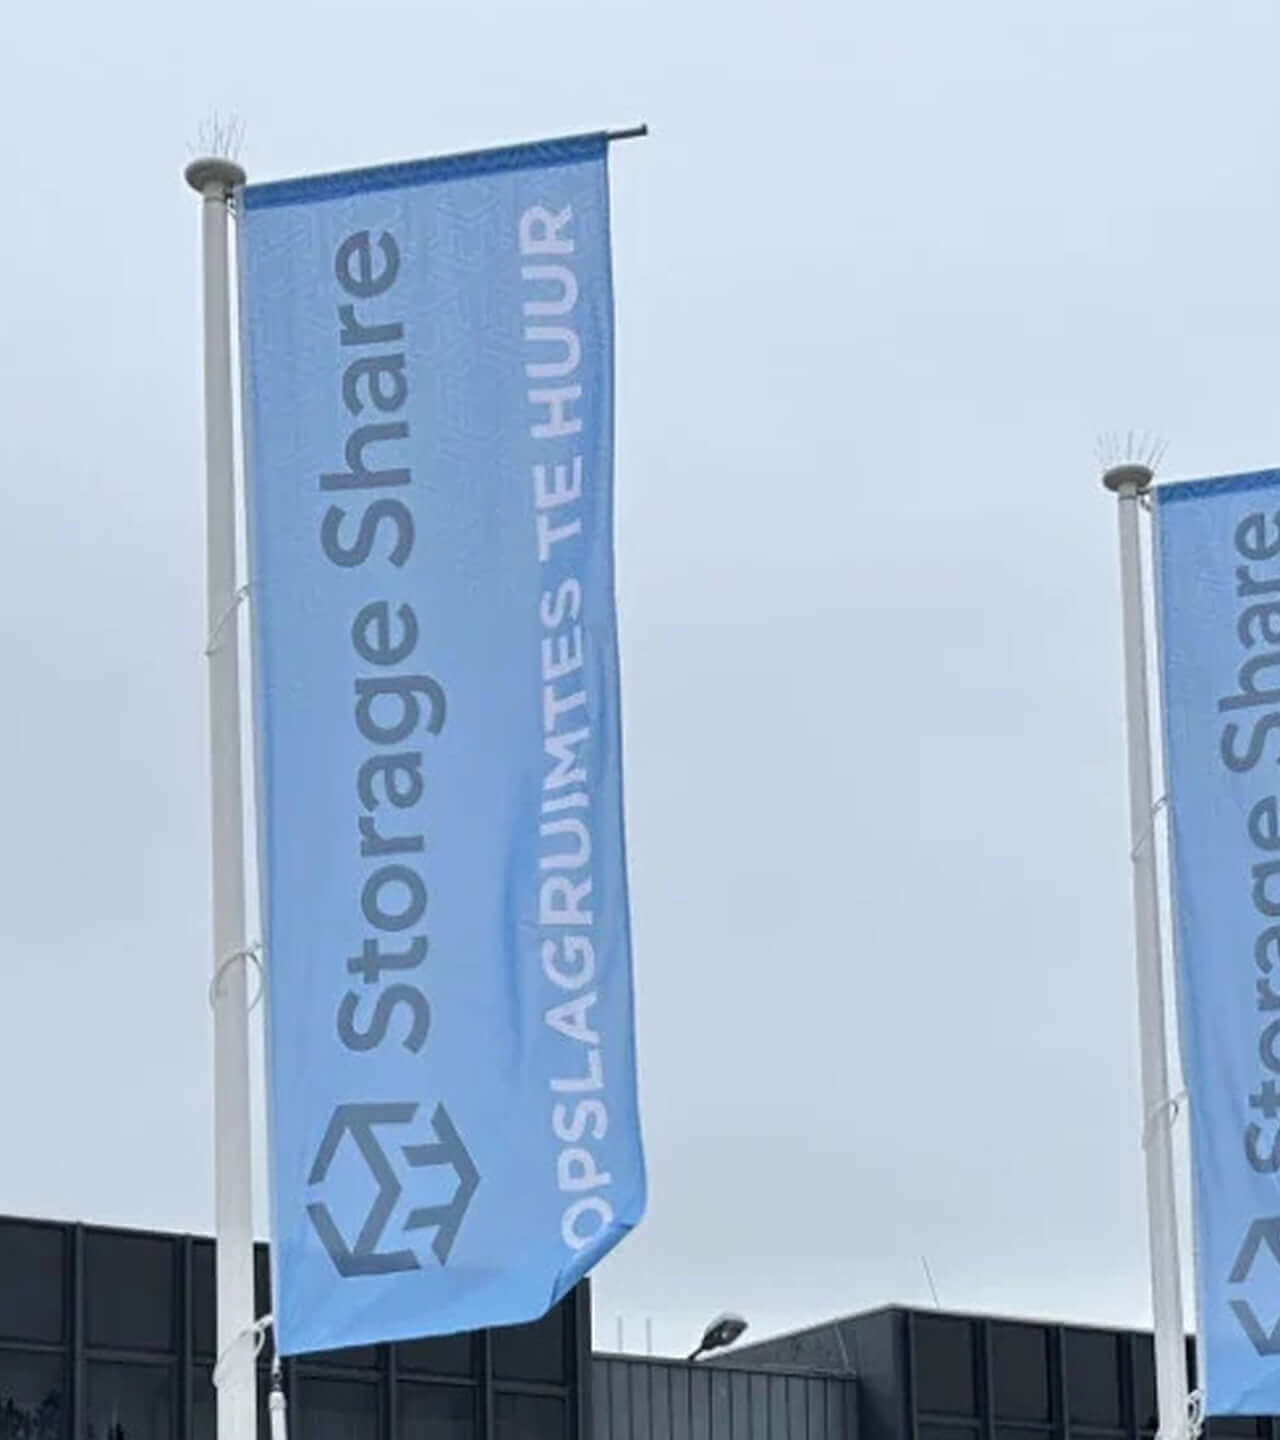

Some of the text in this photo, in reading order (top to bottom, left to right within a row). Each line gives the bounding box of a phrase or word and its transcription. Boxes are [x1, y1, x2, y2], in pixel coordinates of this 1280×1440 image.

[320, 229, 447, 1054] Storage Share
[521, 203, 614, 1250] OPSLAGRUIMTES TE HUUR
